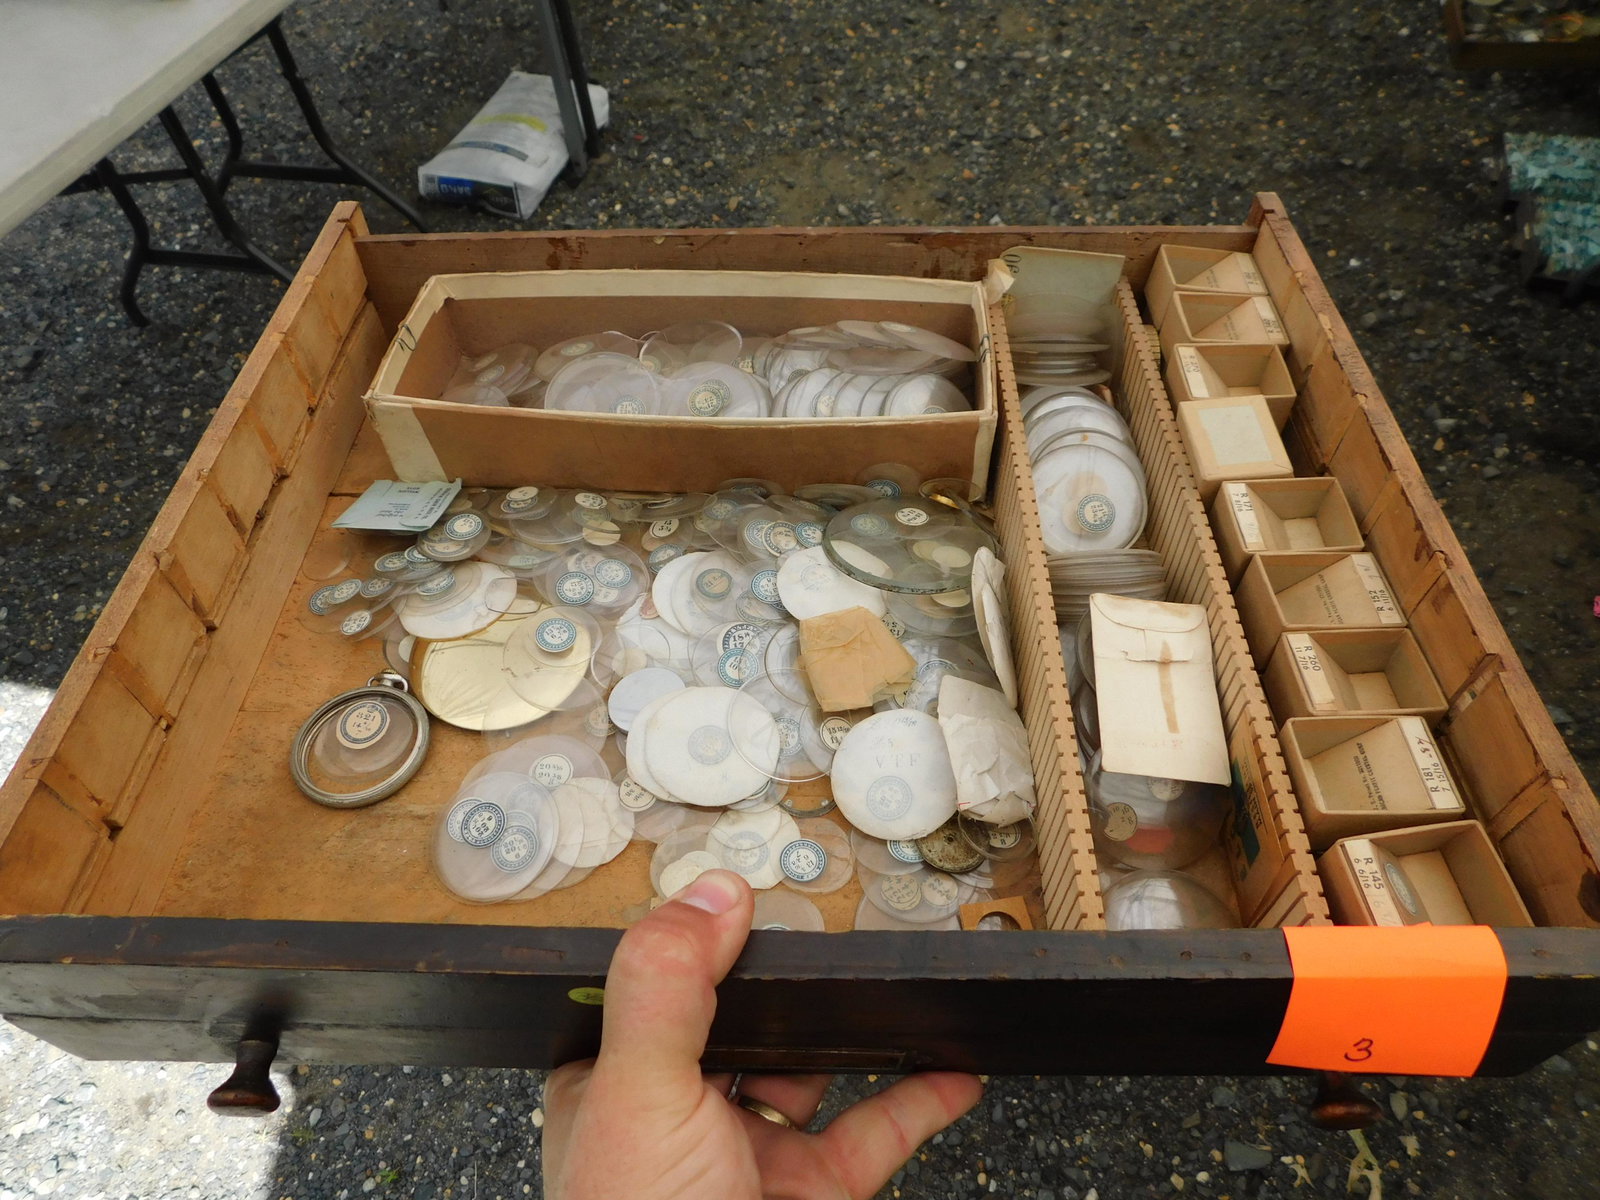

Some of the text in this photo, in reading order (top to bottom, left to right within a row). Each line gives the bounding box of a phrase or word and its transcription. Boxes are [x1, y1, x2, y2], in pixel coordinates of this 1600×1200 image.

[1368, 589, 1381, 603] 152
[1299, 656, 1310, 671] 7/16
[1308, 655, 1321, 672] 260
[1421, 767, 1440, 793] R 181
[1432, 762, 1446, 782] 15/16
[1358, 869, 1371, 888] 6/16
[1364, 857, 1384, 890] R 145
[1344, 1038, 1374, 1062] 3
